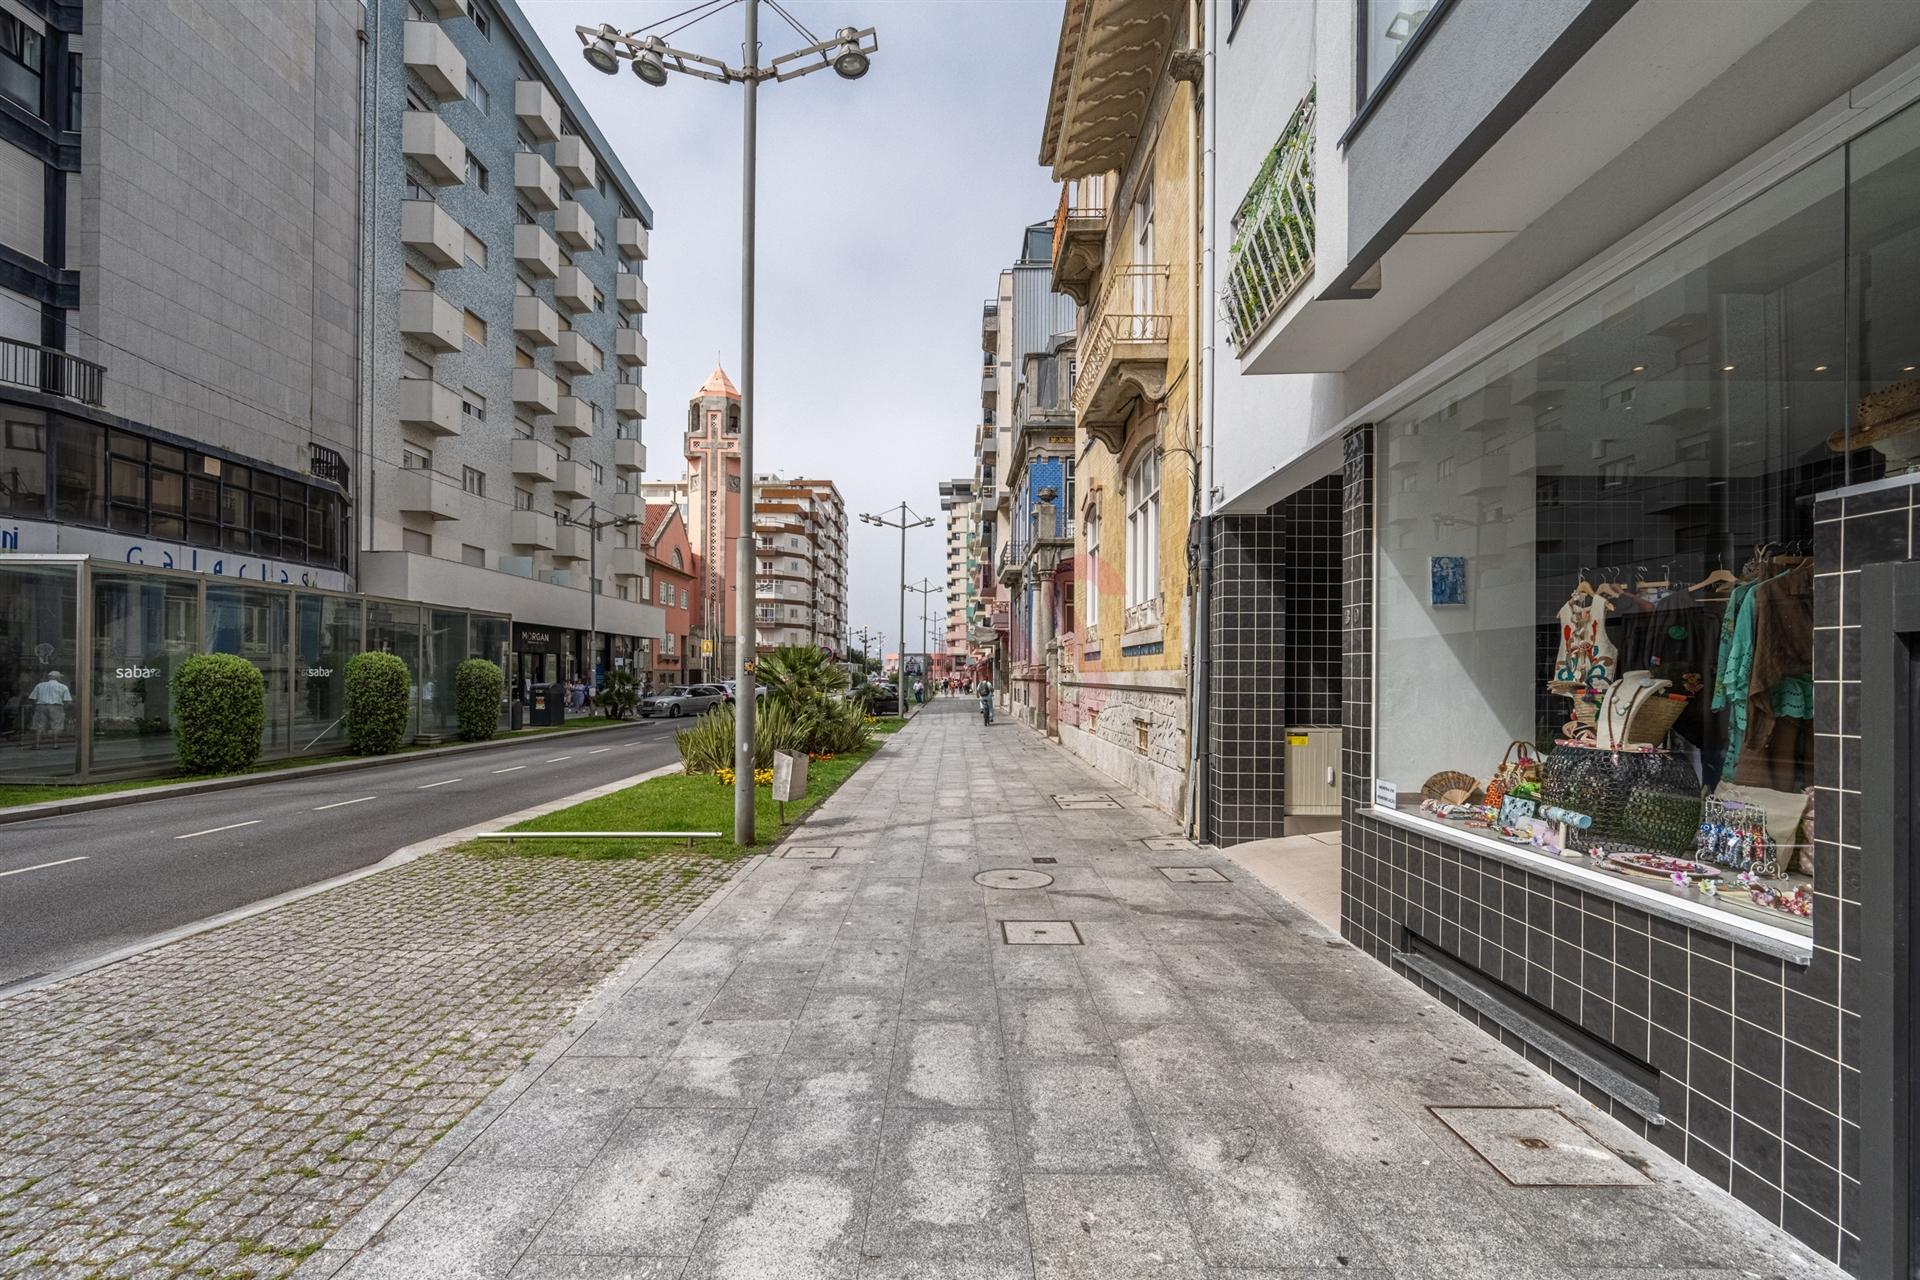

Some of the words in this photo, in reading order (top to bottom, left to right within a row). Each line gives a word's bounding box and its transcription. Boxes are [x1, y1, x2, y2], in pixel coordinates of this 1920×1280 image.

[522, 631, 550, 642] MORGAN
[116, 664, 150, 679] saba
[308, 665, 331, 677] saba
